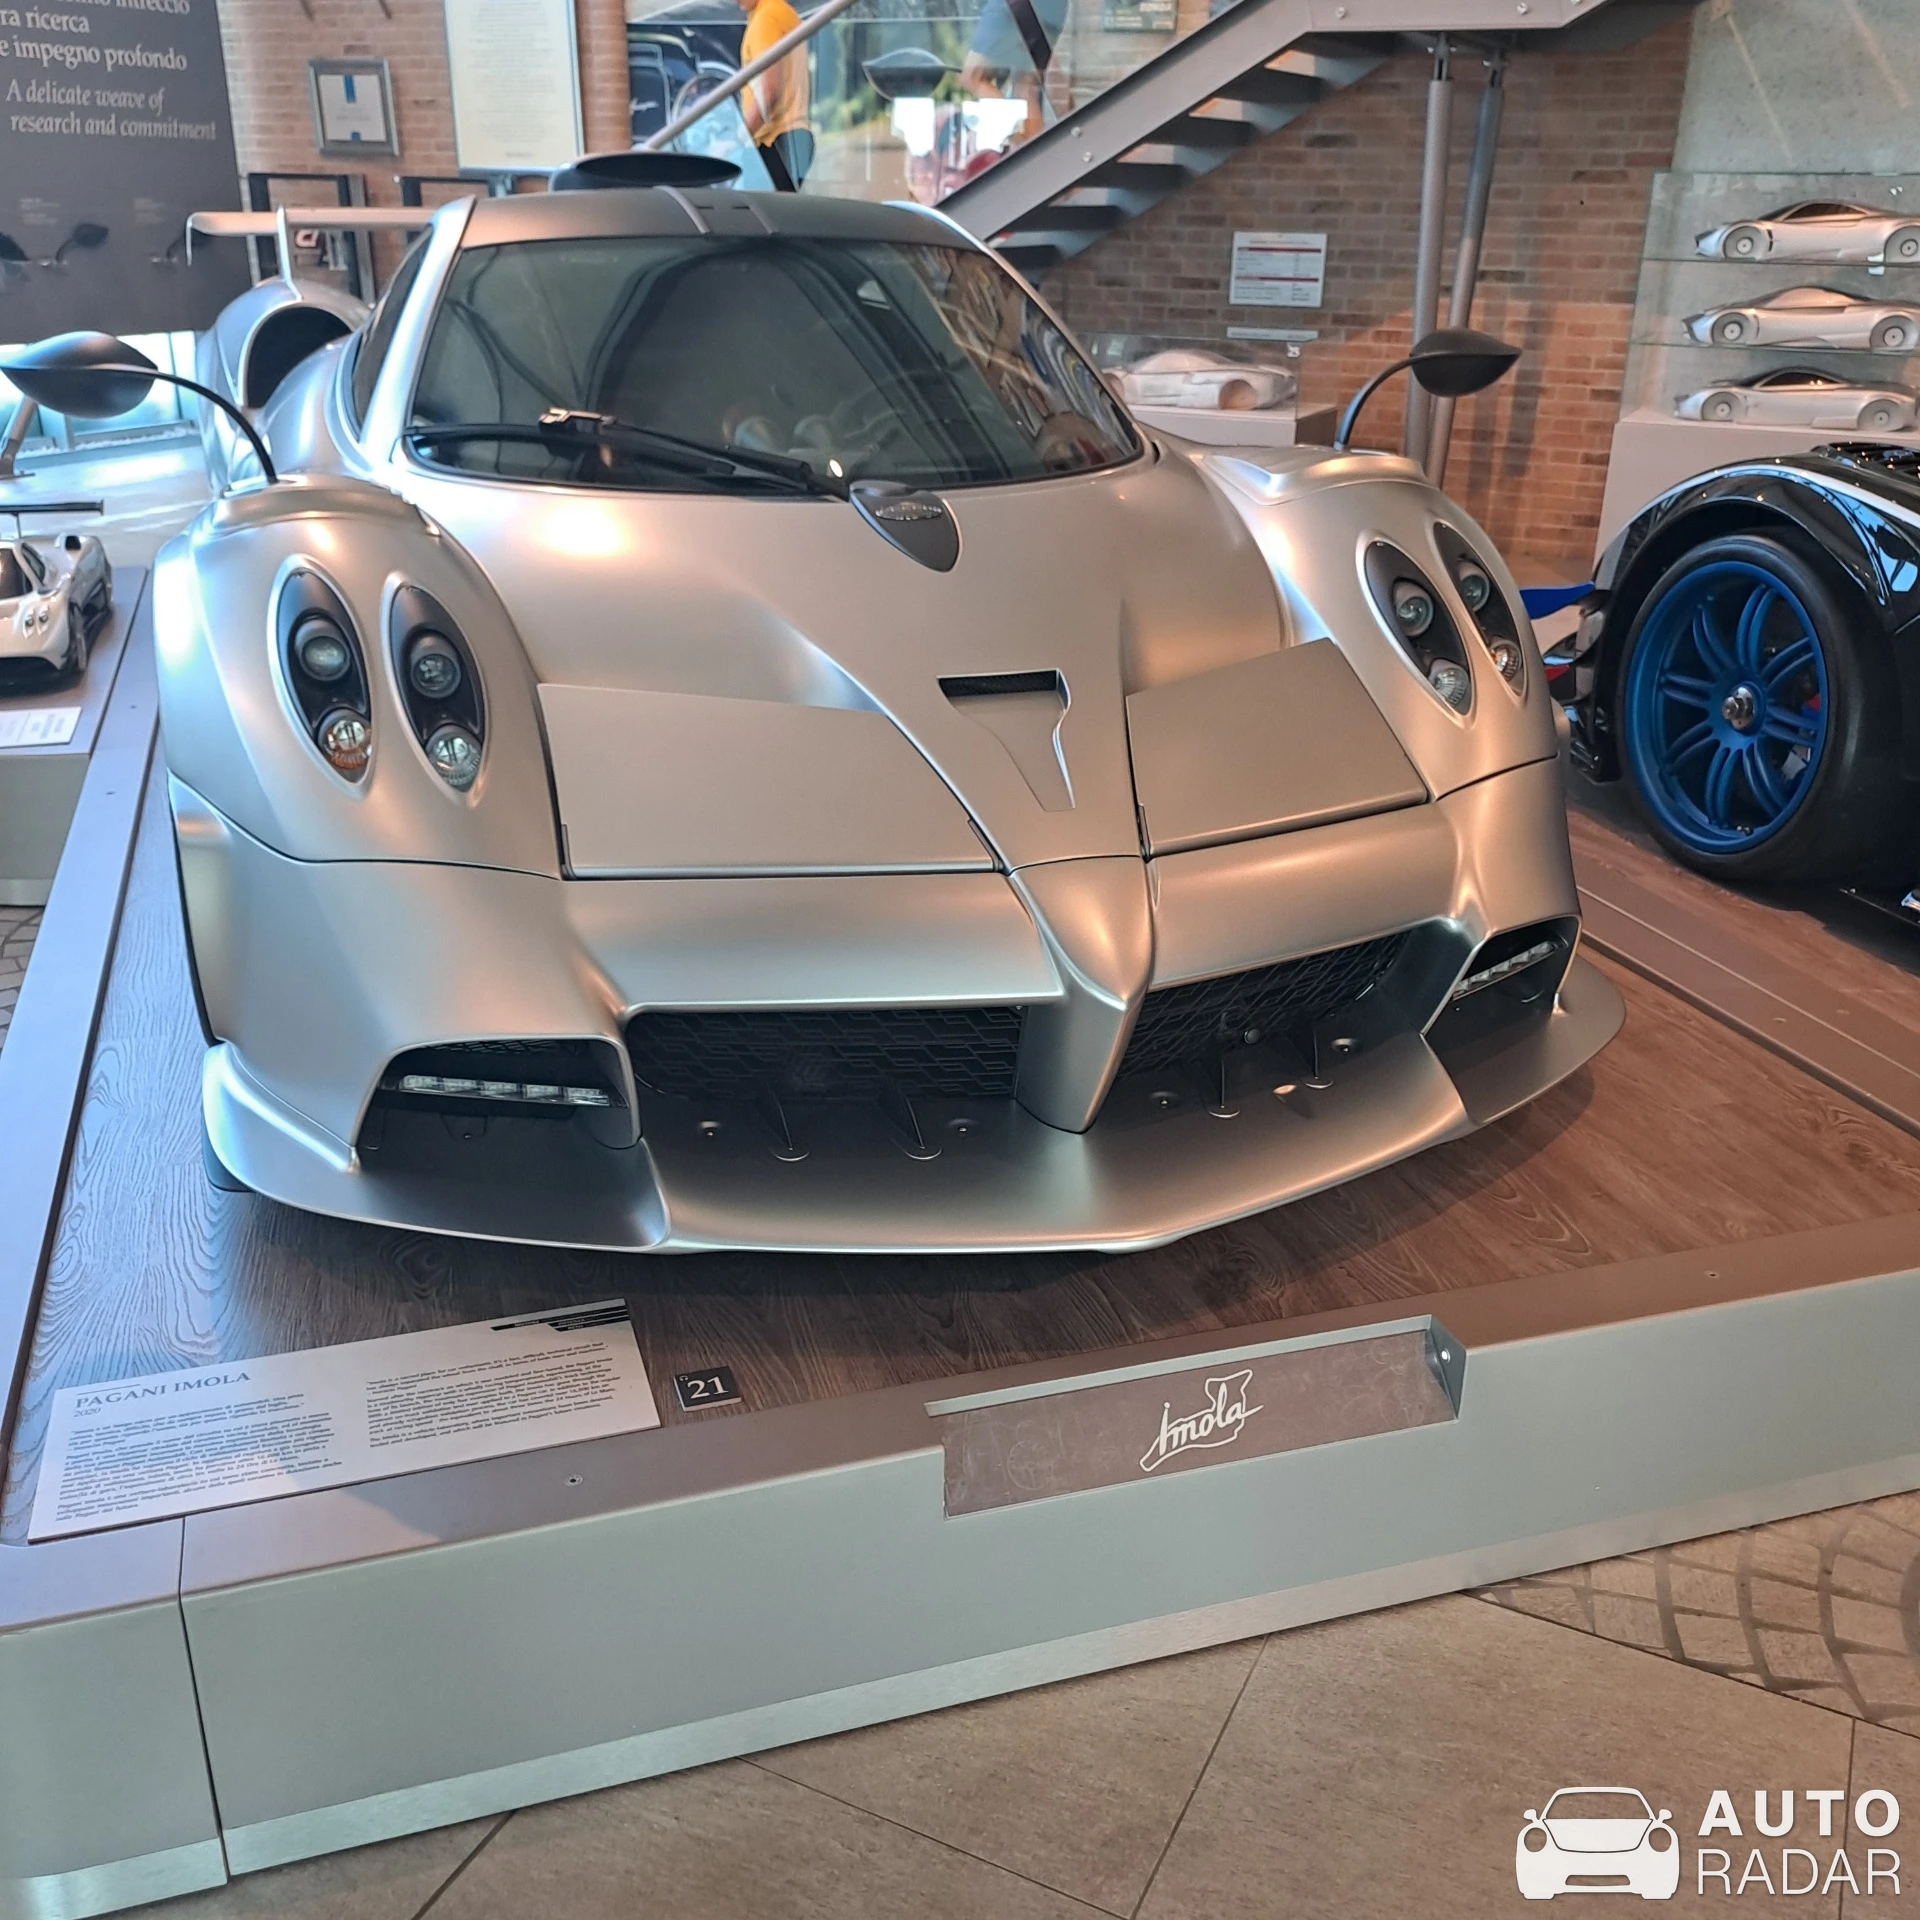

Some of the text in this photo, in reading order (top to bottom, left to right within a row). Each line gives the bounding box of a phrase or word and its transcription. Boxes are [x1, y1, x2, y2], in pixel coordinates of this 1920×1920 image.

[25, 6, 90, 33] ricerca
[0, 35, 187, 72] e impegno profondo
[6, 79, 165, 117] A delicate weave of
[11, 111, 216, 140] research and commitment
[75, 1372, 251, 1408] PAGANI IMOLA
[687, 1376, 729, 1399] 21
[73, 1408, 102, 1418] 2020
